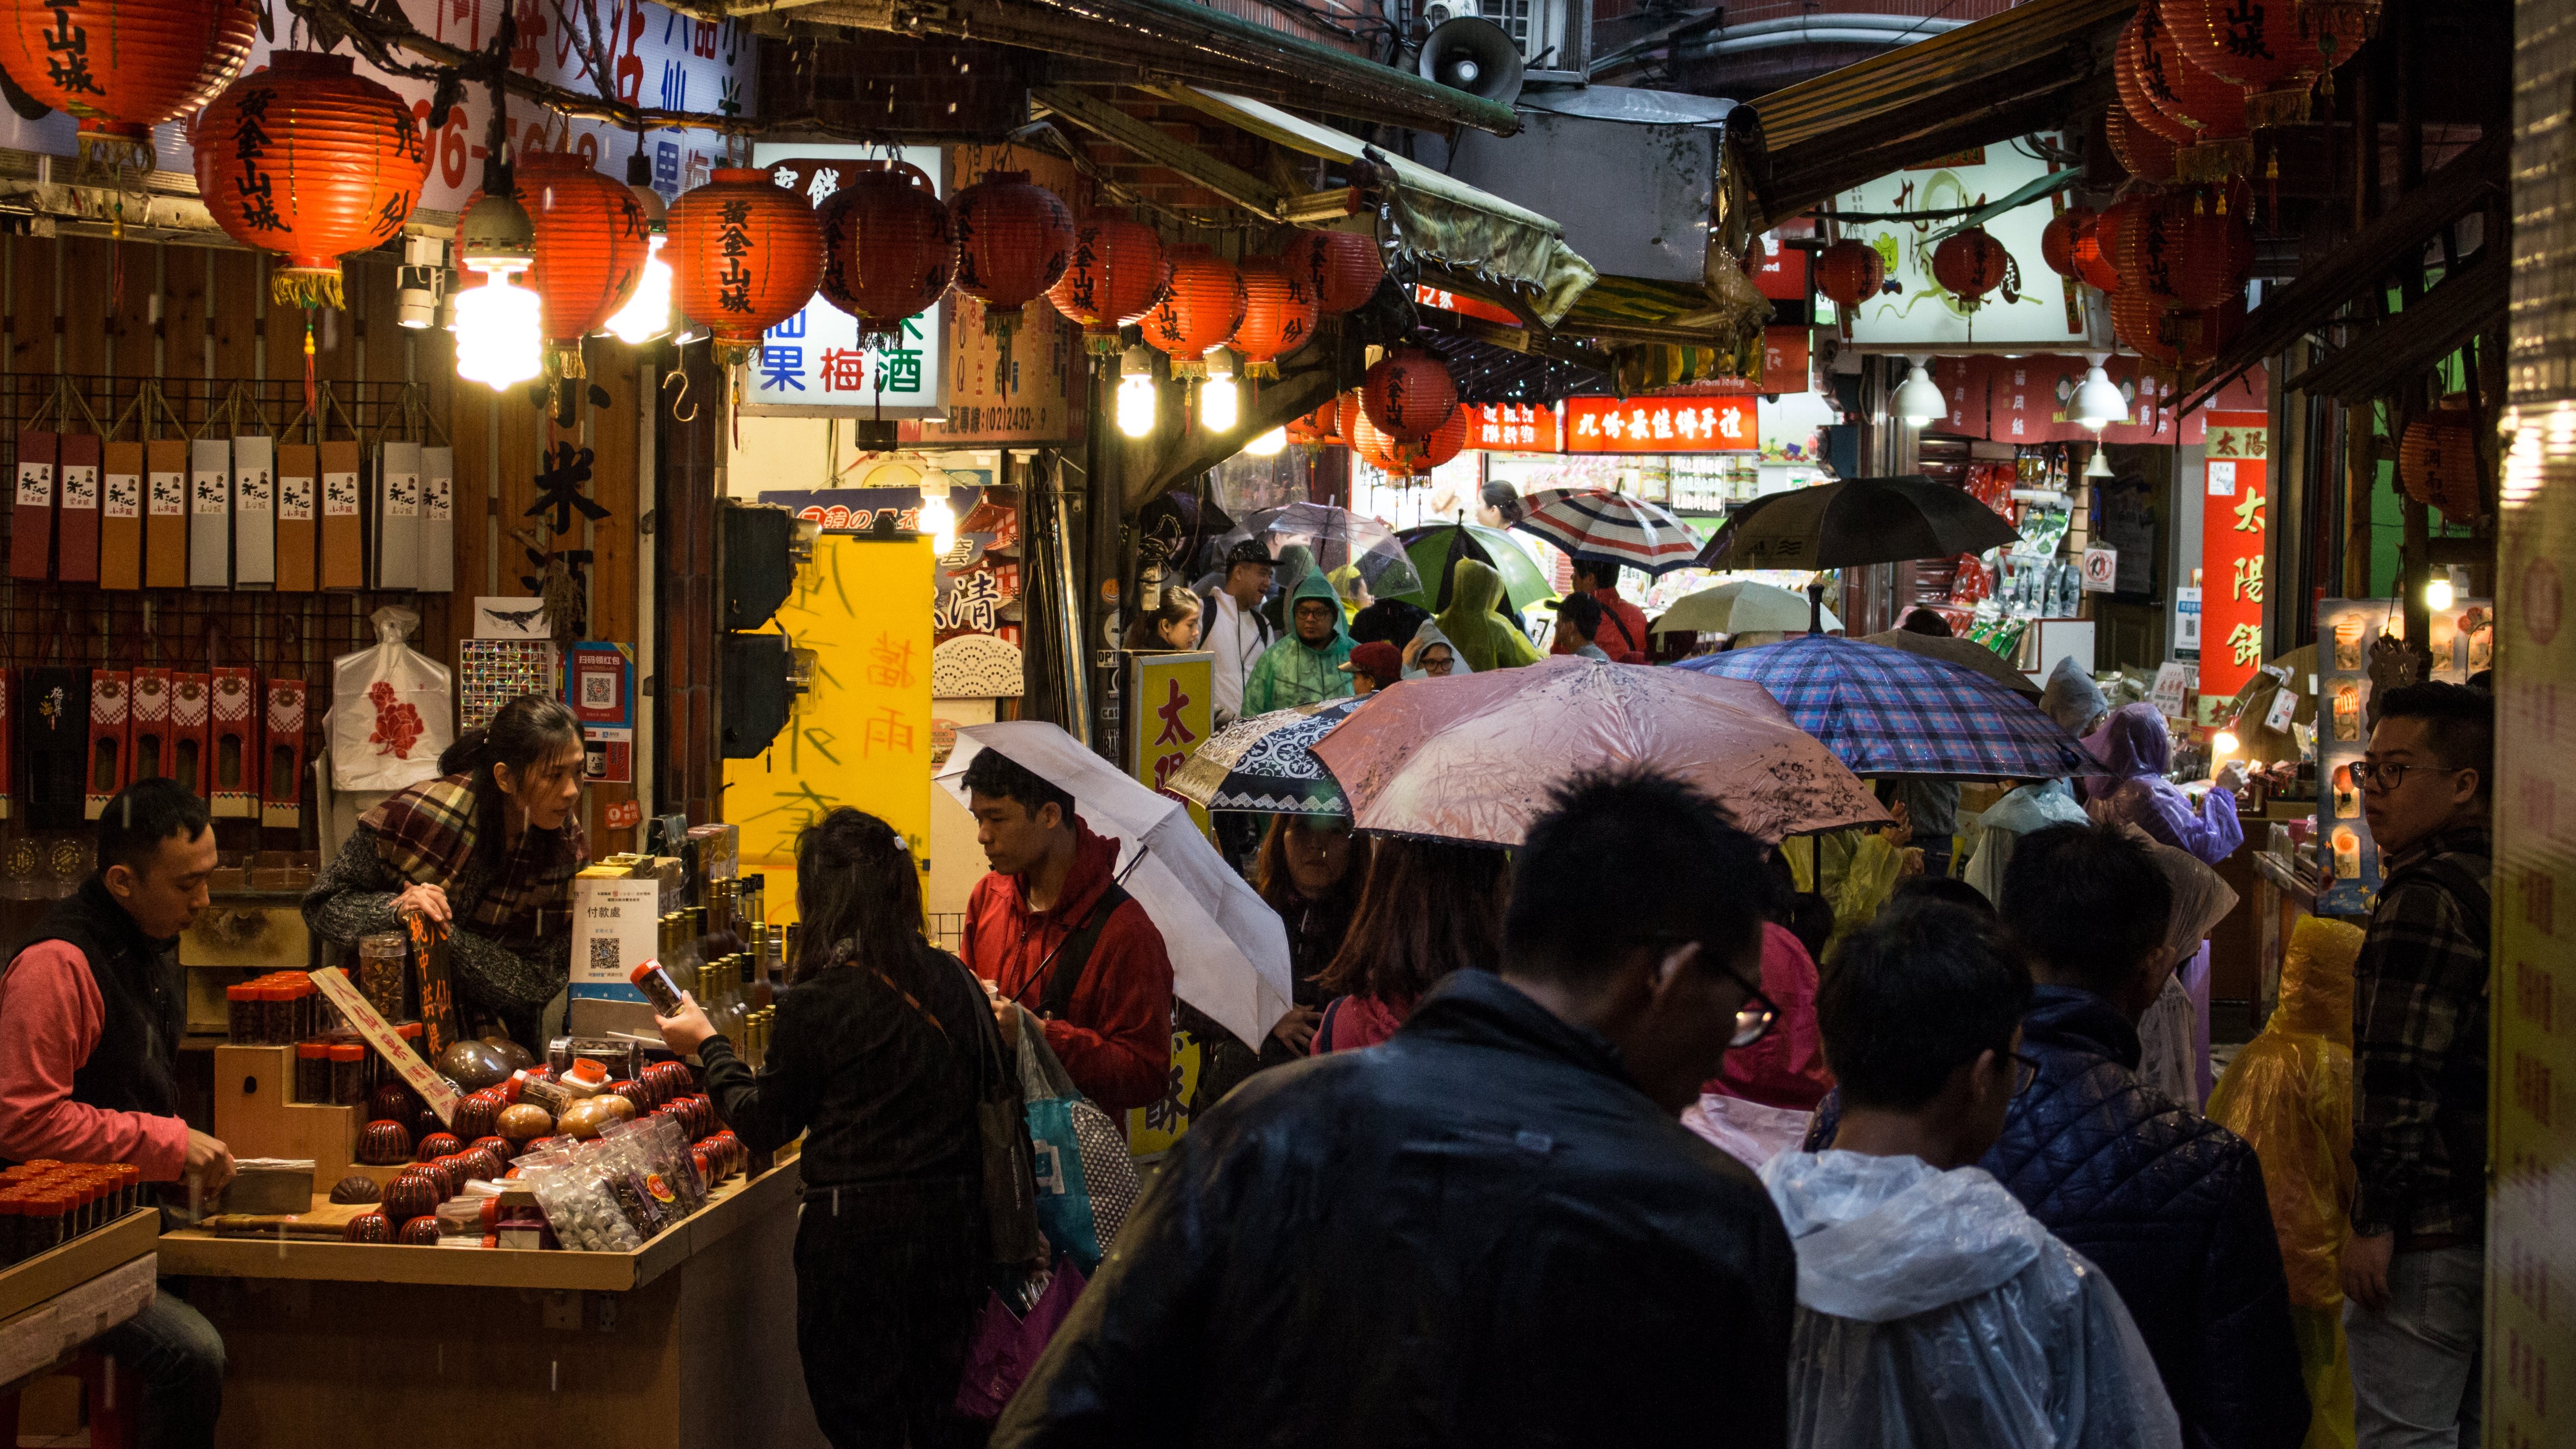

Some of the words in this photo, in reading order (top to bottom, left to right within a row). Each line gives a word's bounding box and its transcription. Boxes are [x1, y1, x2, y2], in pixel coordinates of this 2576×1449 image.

[715, 199, 754, 314] 黃金山城
[1072, 227, 1100, 313] 黃金山城
[819, 347, 865, 393] 梅
[1577, 407, 1743, 440] 九份最佳伴手禮
[579, 655, 620, 665] 扫码领红包
[587, 906, 621, 918] 付款處
